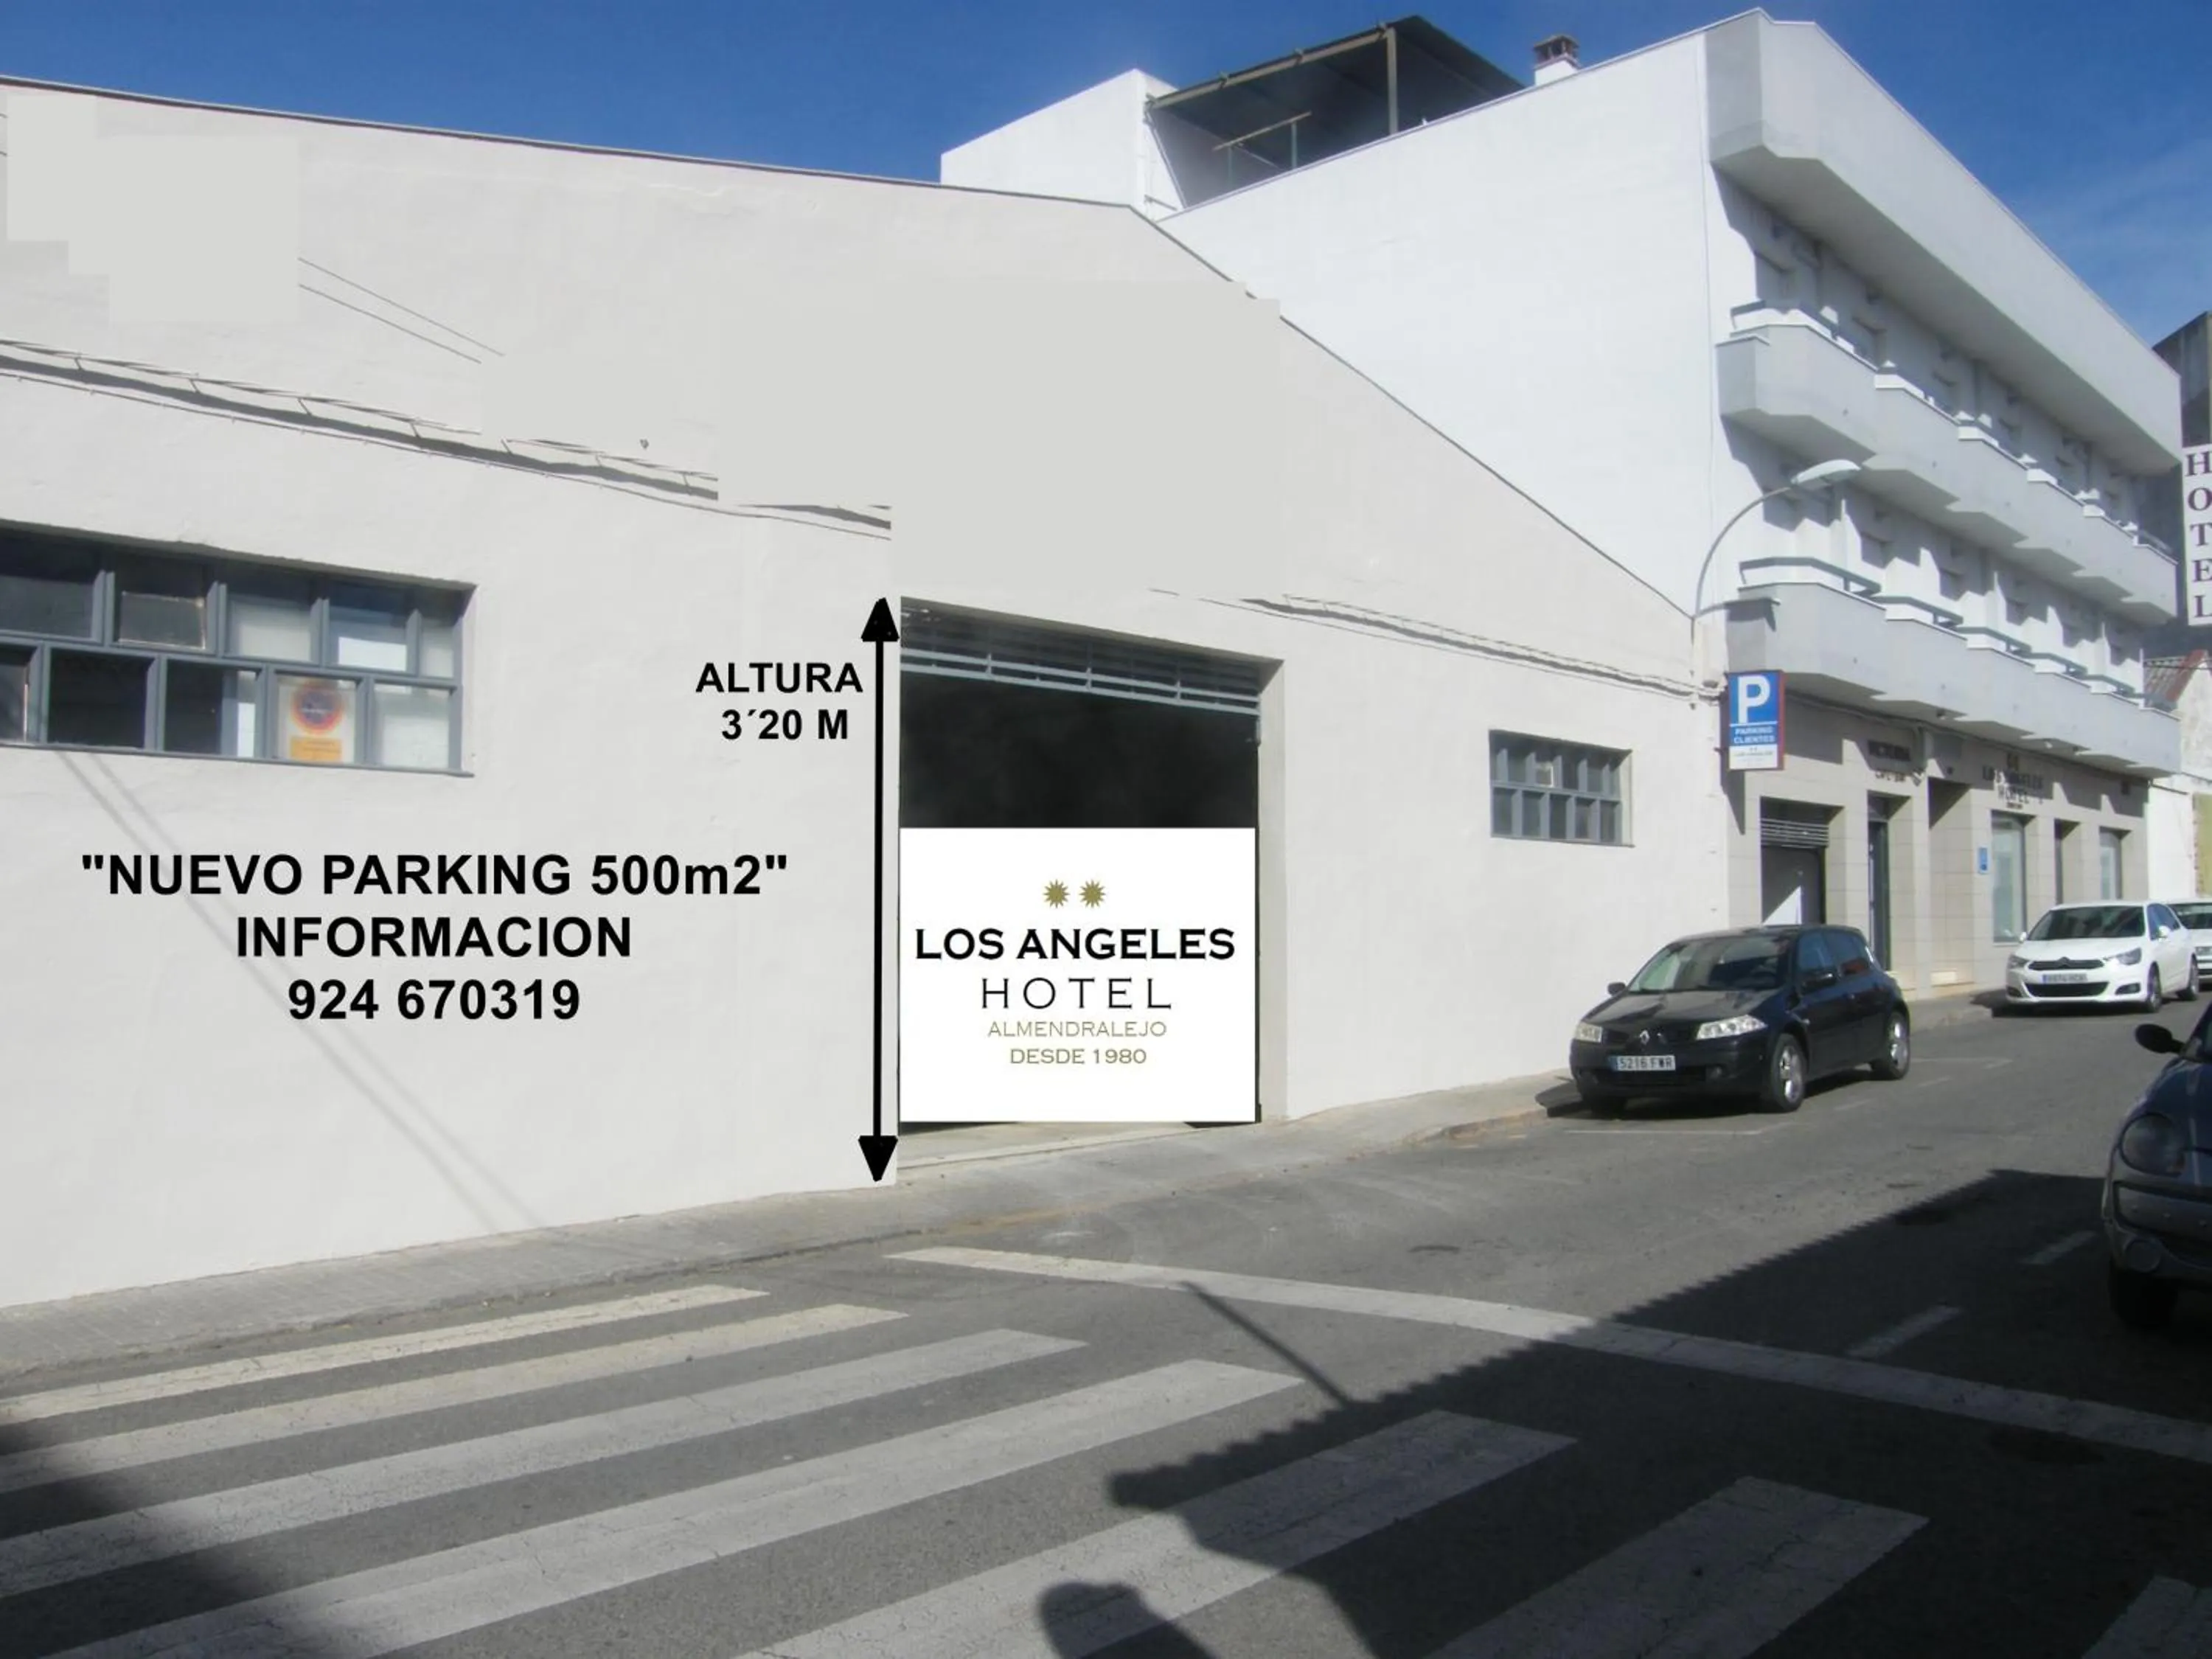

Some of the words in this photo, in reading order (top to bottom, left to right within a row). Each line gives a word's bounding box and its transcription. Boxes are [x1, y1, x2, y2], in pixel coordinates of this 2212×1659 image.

[2185, 450, 2212, 619] HOTEL
[1738, 675, 1770, 724] P
[1733, 735, 1775, 744] CLIENTES
[1734, 726, 1773, 735] PARKING
